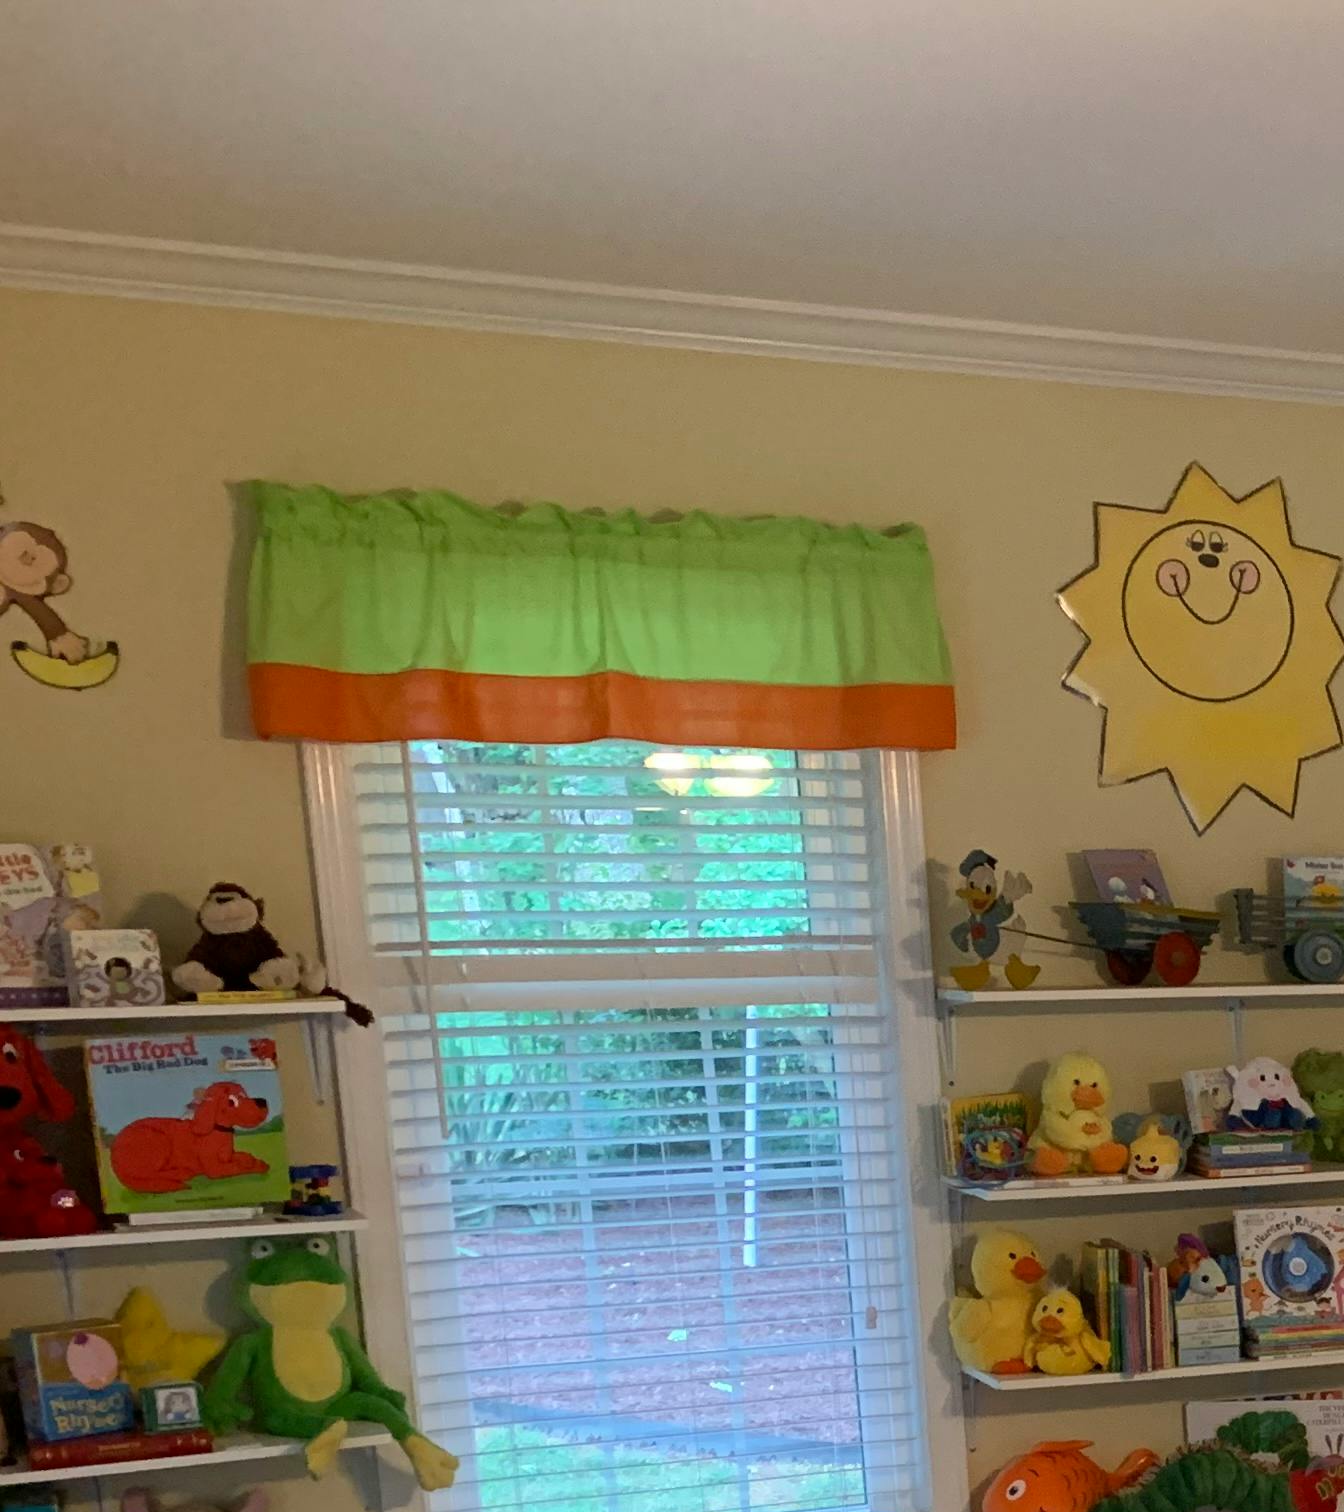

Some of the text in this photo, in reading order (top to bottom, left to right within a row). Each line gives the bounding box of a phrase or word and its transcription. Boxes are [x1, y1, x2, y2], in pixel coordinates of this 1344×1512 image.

[89, 1034, 198, 1065] Clifford
[103, 1056, 209, 1074] The Big Red Dog
